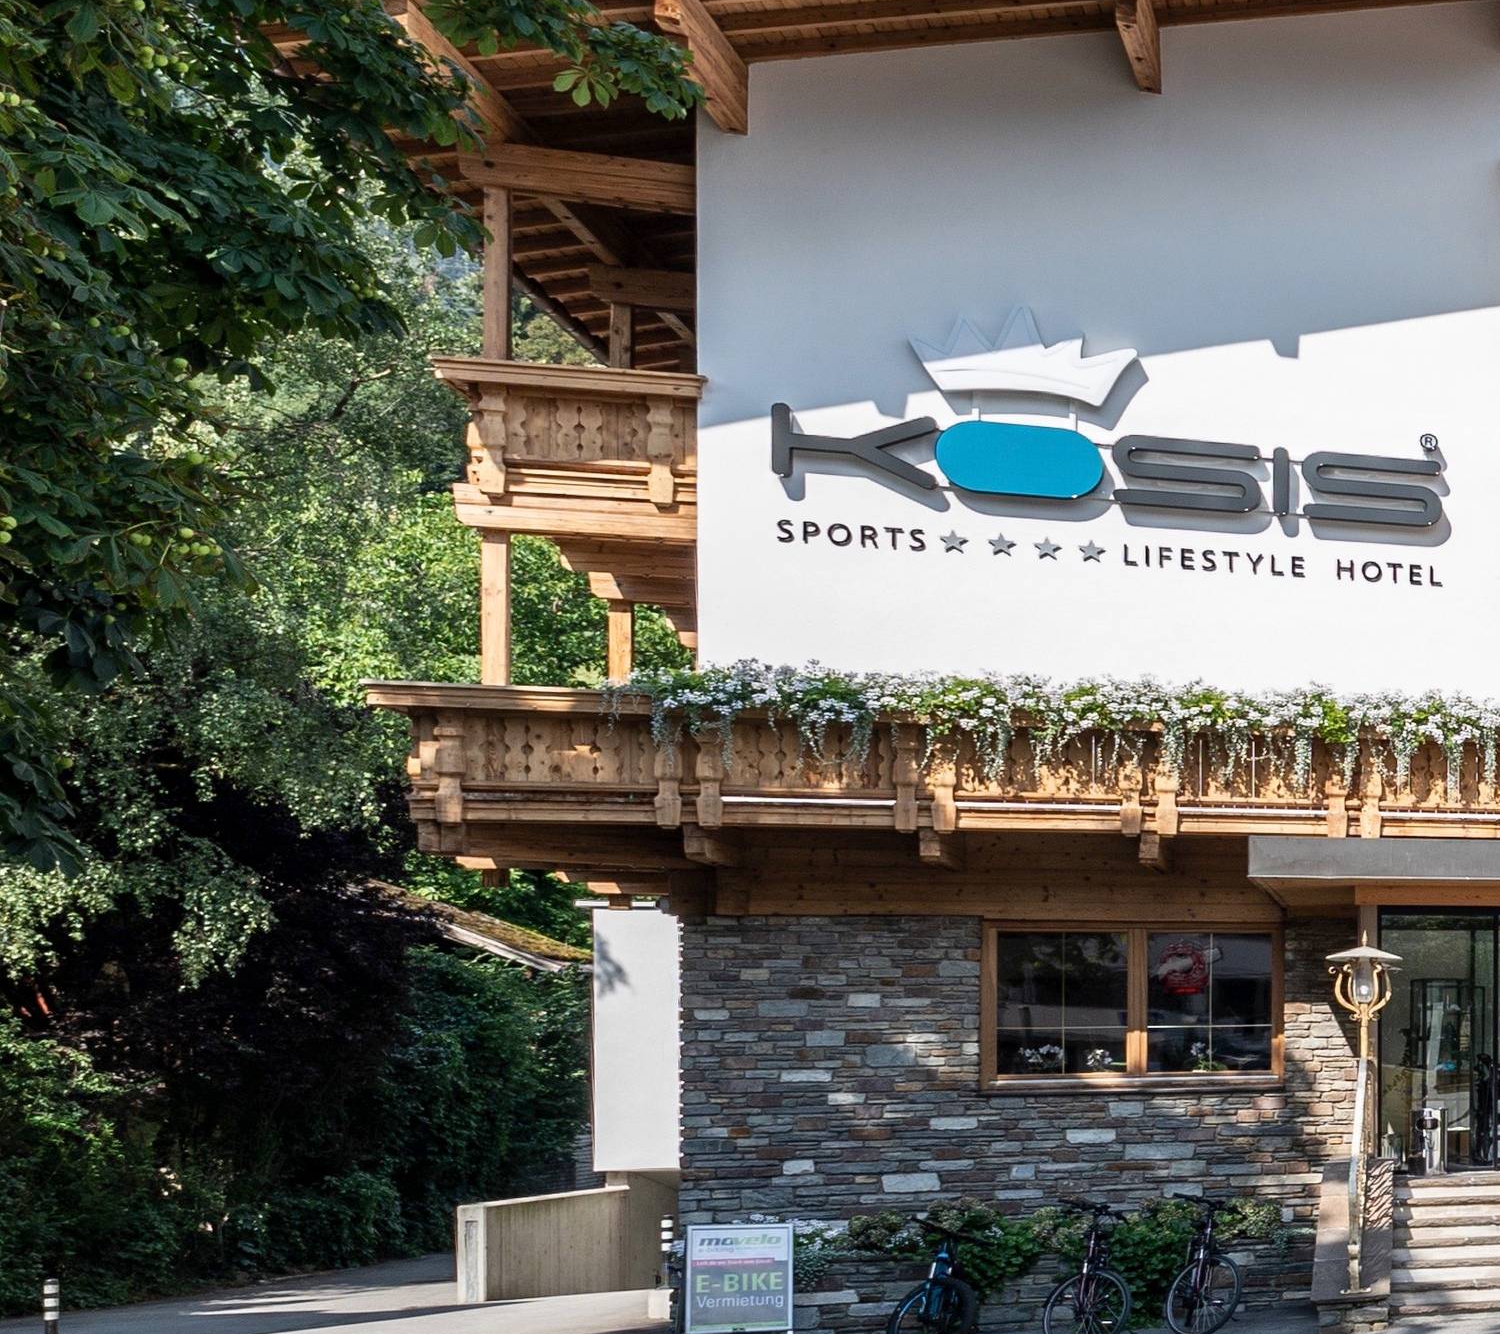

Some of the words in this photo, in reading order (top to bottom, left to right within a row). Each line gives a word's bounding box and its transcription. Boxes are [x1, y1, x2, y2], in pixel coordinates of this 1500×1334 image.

[770, 403, 1444, 527] KOSIS
[776, 518, 927, 552] SPORTS
[1122, 543, 1306, 578] LIFESTYLE
[1336, 558, 1443, 587] HOTEL
[696, 1271, 784, 1293] E-BIKE
[696, 1294, 785, 1308] Vermietung
